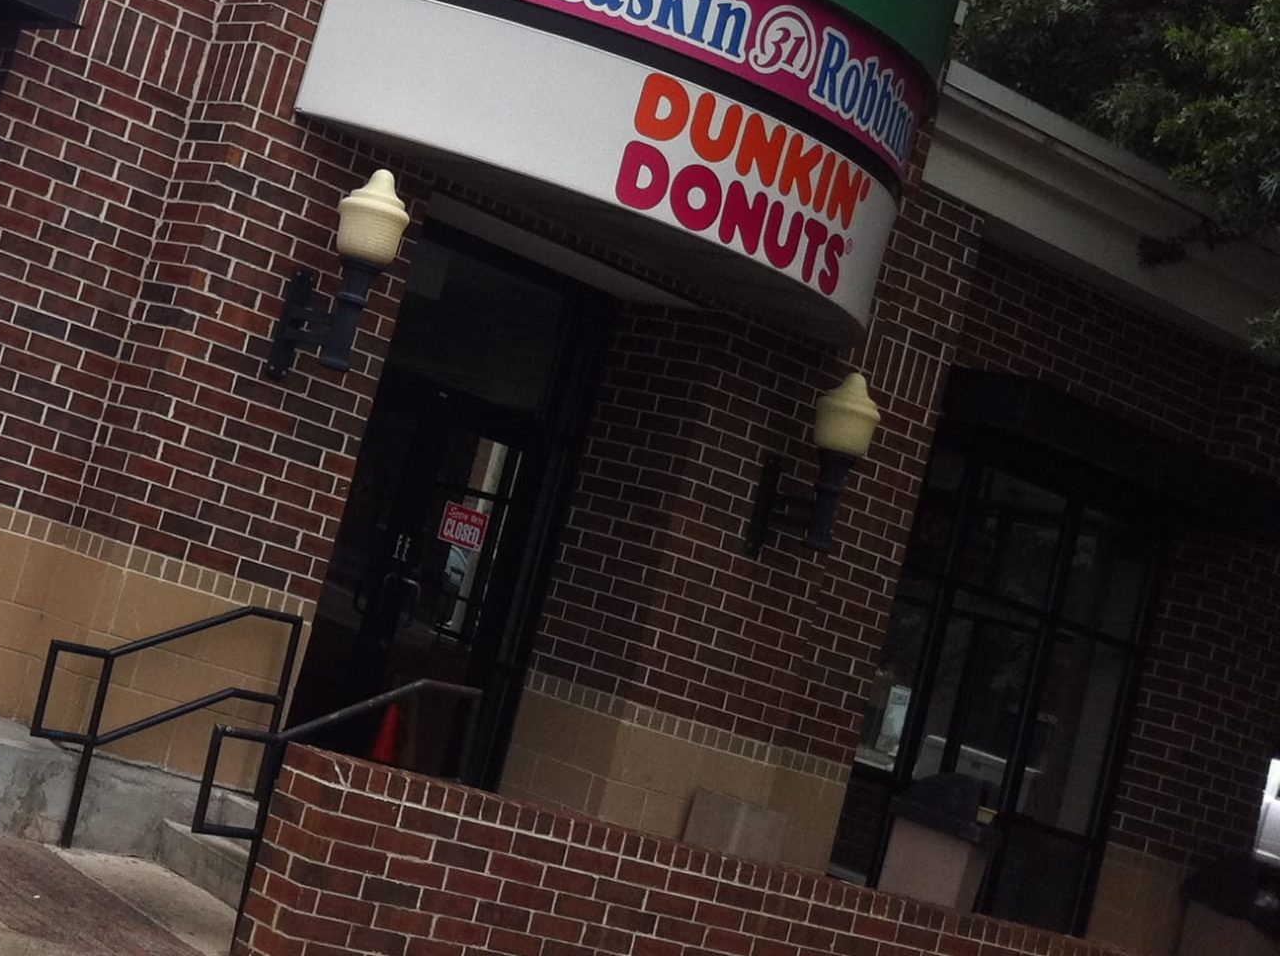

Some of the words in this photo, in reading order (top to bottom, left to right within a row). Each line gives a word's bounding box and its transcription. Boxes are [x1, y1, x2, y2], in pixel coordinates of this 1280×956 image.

[753, 24, 808, 74] 31
[634, 72, 870, 230] DUNKIN'
[442, 517, 481, 545] CLOSED
